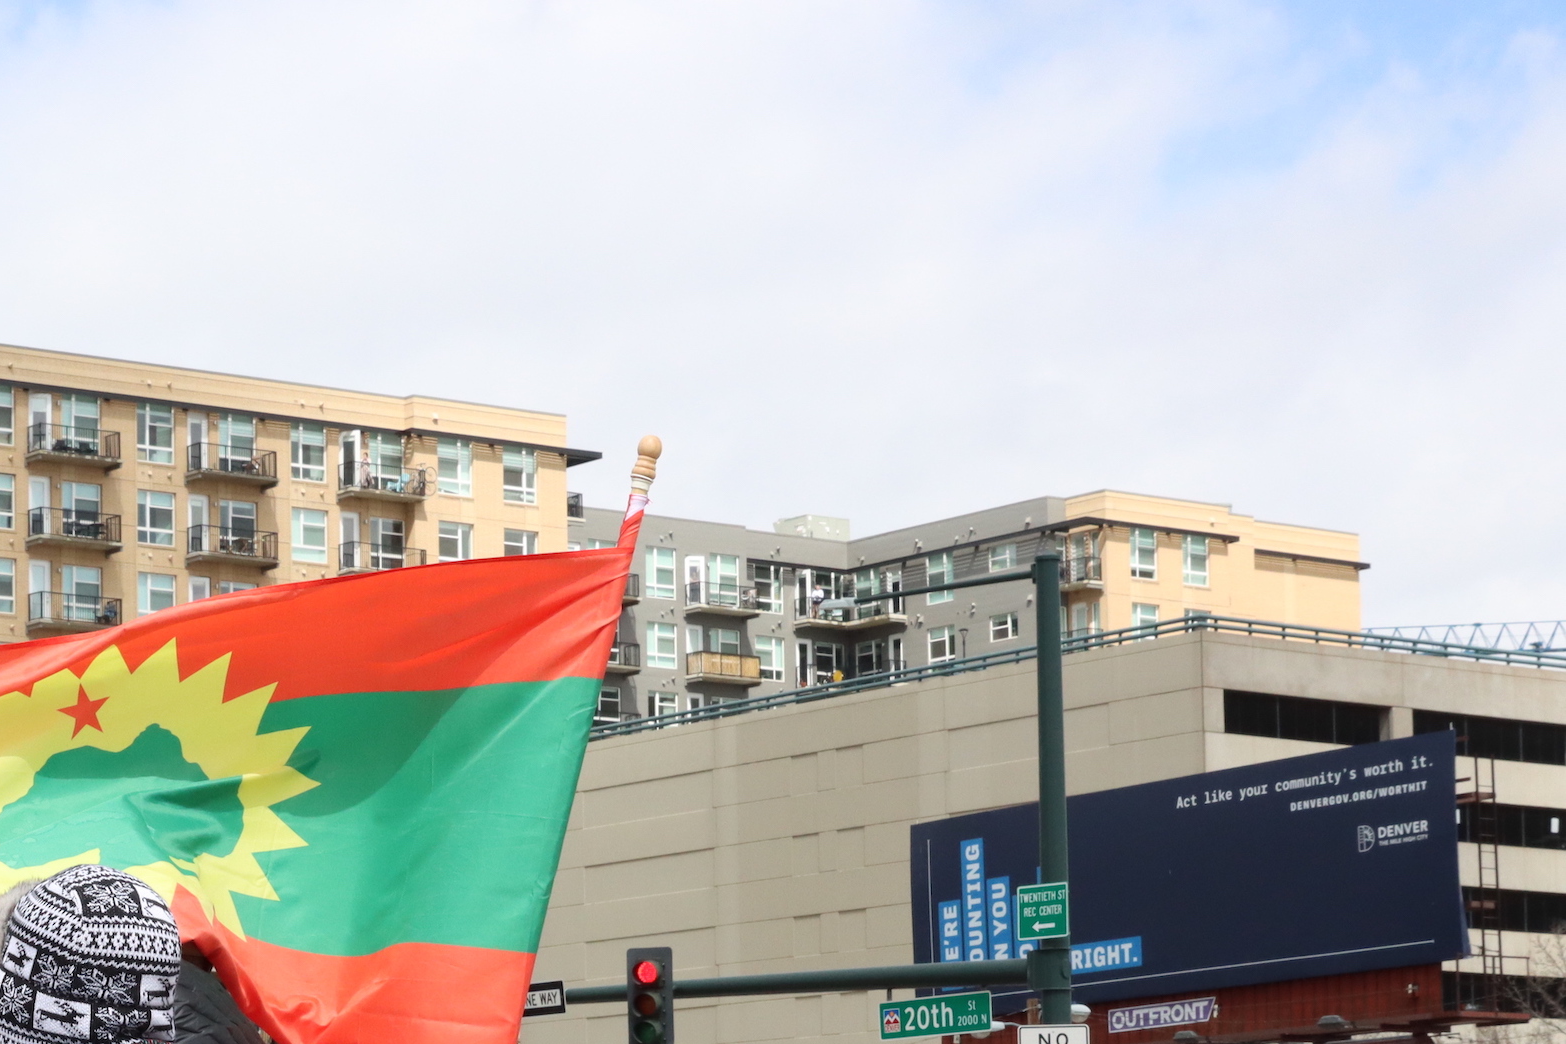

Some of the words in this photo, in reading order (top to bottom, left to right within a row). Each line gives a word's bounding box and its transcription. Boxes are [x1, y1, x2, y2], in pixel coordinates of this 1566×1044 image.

[1176, 795, 1197, 809] Act
[1204, 790, 1233, 805] like
[1239, 784, 1268, 801] your
[1275, 769, 1357, 793] community's
[1364, 759, 1403, 777] worth
[1411, 755, 1433, 770] it.
[1290, 781, 1428, 812] DENVERGOV.ORG/WORTHIT
[1378, 820, 1428, 838] DENVER
[965, 844, 983, 962] OUNTING
[992, 883, 1007, 936] YOU
[1020, 891, 1056, 903] TWENTIETH
[1058, 889, 1066, 900] ST
[1024, 907, 1036, 917] REC
[1039, 904, 1062, 916] CENTER
[943, 905, 959, 961] E'RE
[994, 943, 1009, 961] N
[1071, 943, 1138, 970] RIGHT.
[539, 991, 557, 1006] WAY
[904, 1002, 954, 1031] 20th
[968, 1000, 976, 1011] St
[957, 1015, 978, 1026] 2000
[981, 1014, 987, 1024] N
[1112, 1000, 1209, 1029] OUTFRONT
